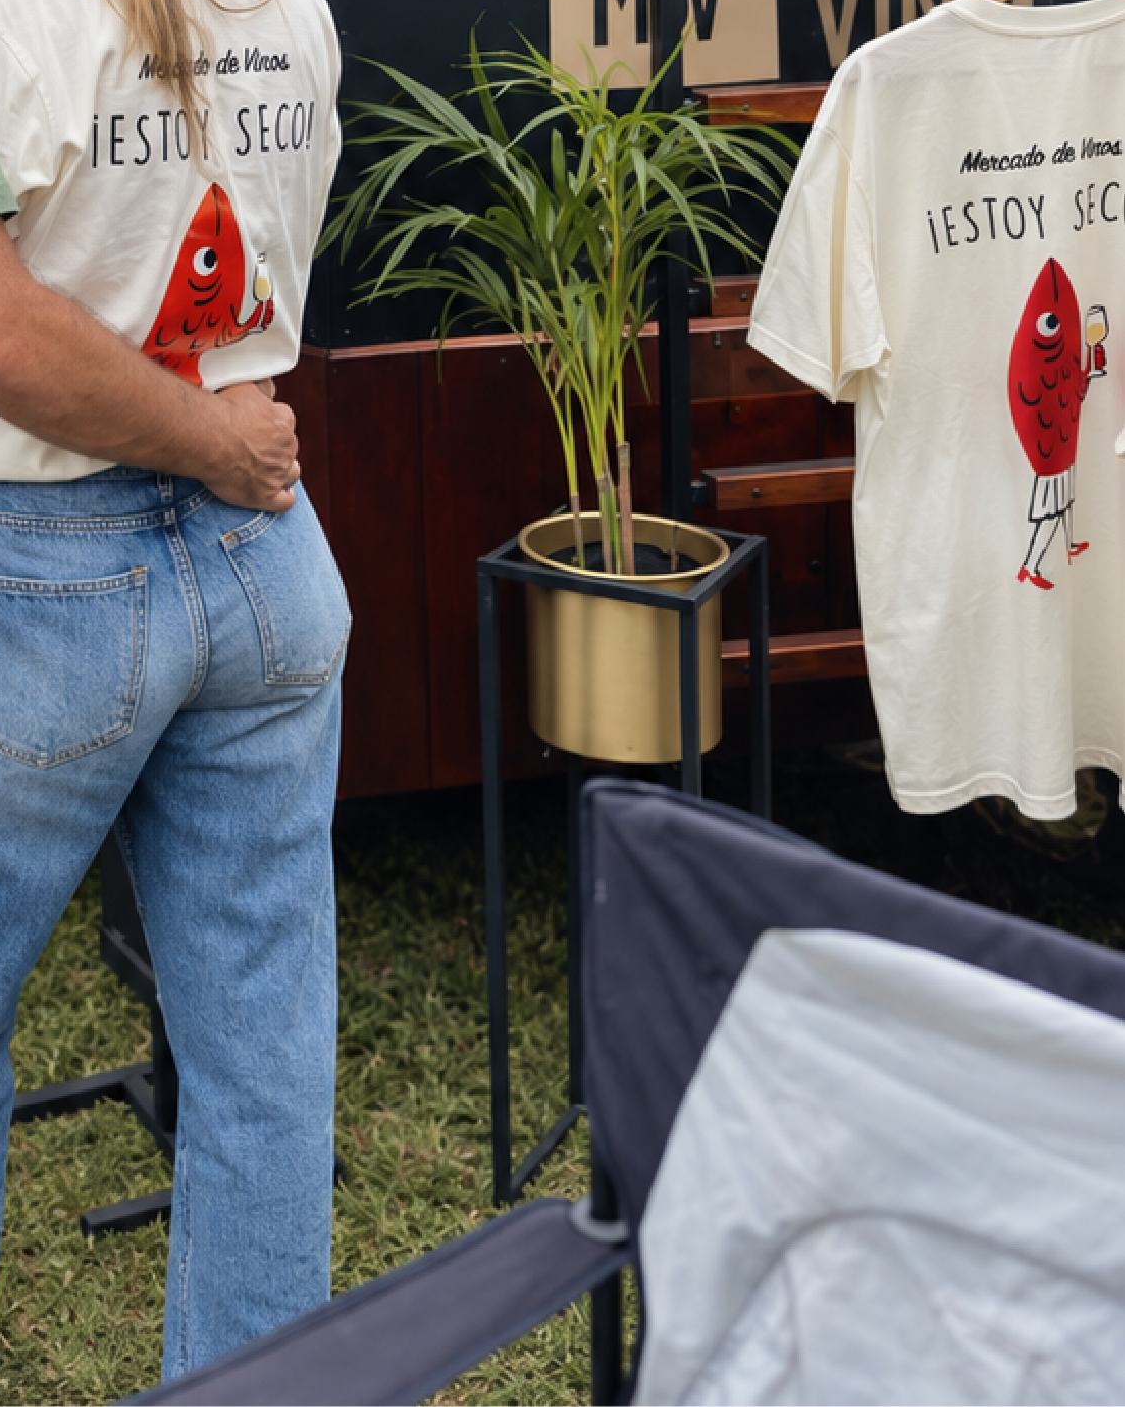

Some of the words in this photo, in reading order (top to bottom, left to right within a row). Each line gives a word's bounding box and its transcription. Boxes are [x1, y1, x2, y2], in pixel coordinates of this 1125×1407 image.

[216, 48, 241, 75] de
[244, 45, 291, 73] Vinos
[235, 100, 315, 157] SECO!
[959, 143, 1047, 175] Mercado
[1051, 140, 1077, 165] de
[926, 193, 1046, 255] ¡ESTOY
[1072, 180, 1125, 232] SEC
